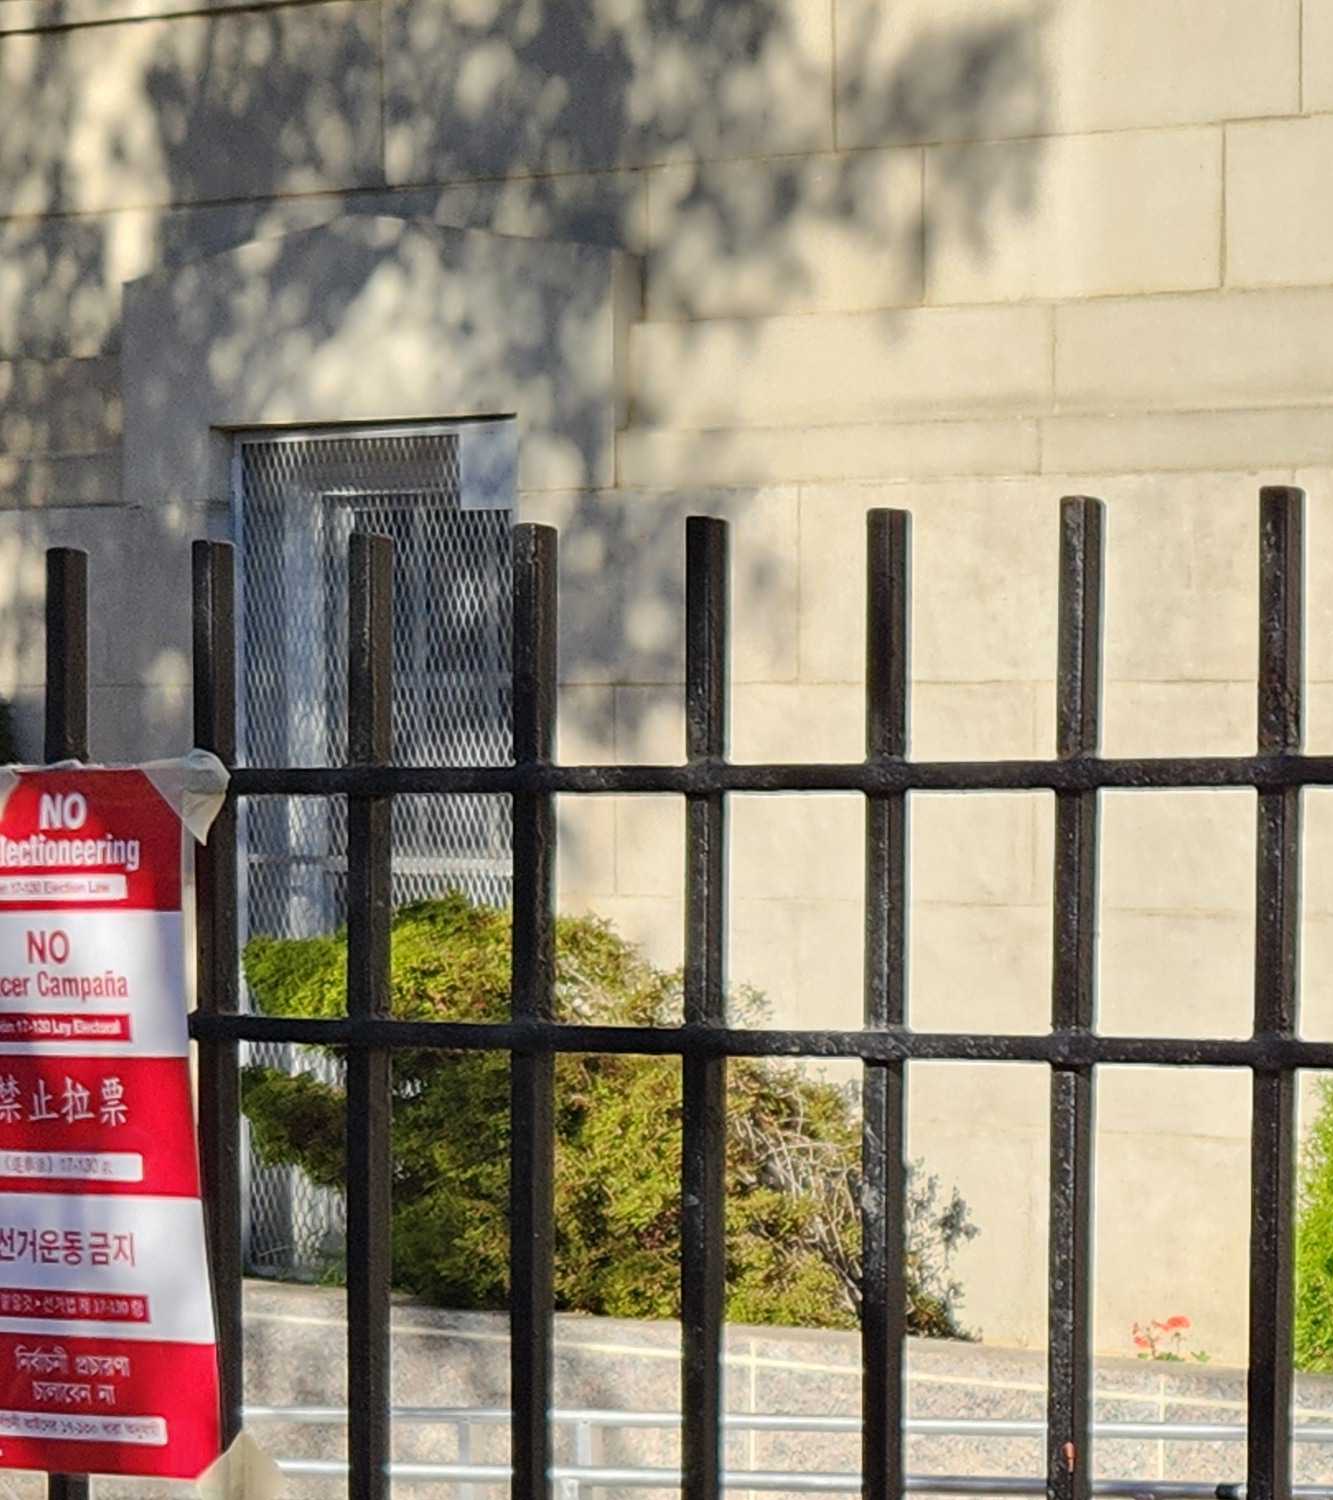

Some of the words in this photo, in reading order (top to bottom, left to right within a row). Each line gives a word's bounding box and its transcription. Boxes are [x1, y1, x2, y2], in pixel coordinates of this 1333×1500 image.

[38, 791, 88, 831] NO
[0, 833, 140, 871] lectioneering
[26, 929, 70, 964] NO
[37, 970, 128, 1001] Campaña
[0, 1073, 128, 1127] 禁止拉票
